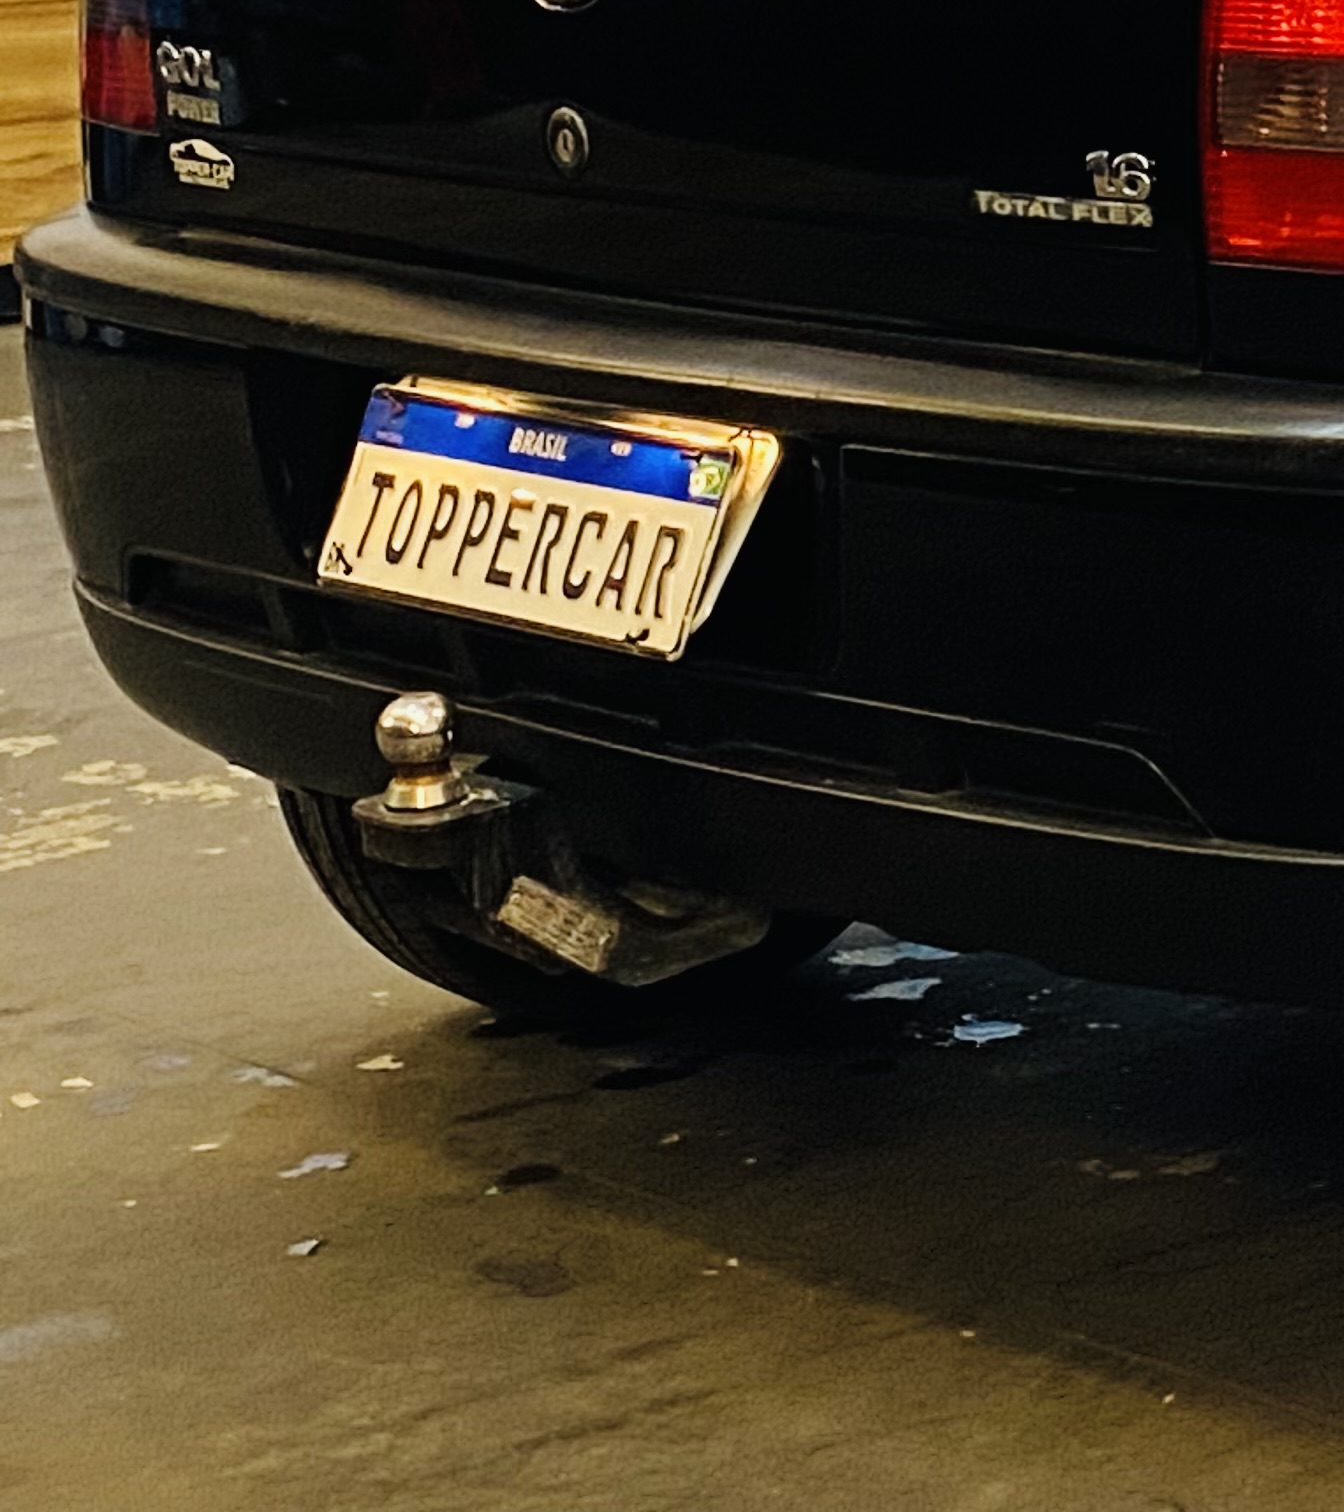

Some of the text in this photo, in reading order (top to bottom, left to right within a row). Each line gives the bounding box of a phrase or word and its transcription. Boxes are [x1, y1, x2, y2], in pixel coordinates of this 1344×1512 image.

[974, 189, 1154, 228] TOTAL FLEX
[509, 426, 568, 462] BRASIL
[355, 470, 687, 620] TOPPERCAR
